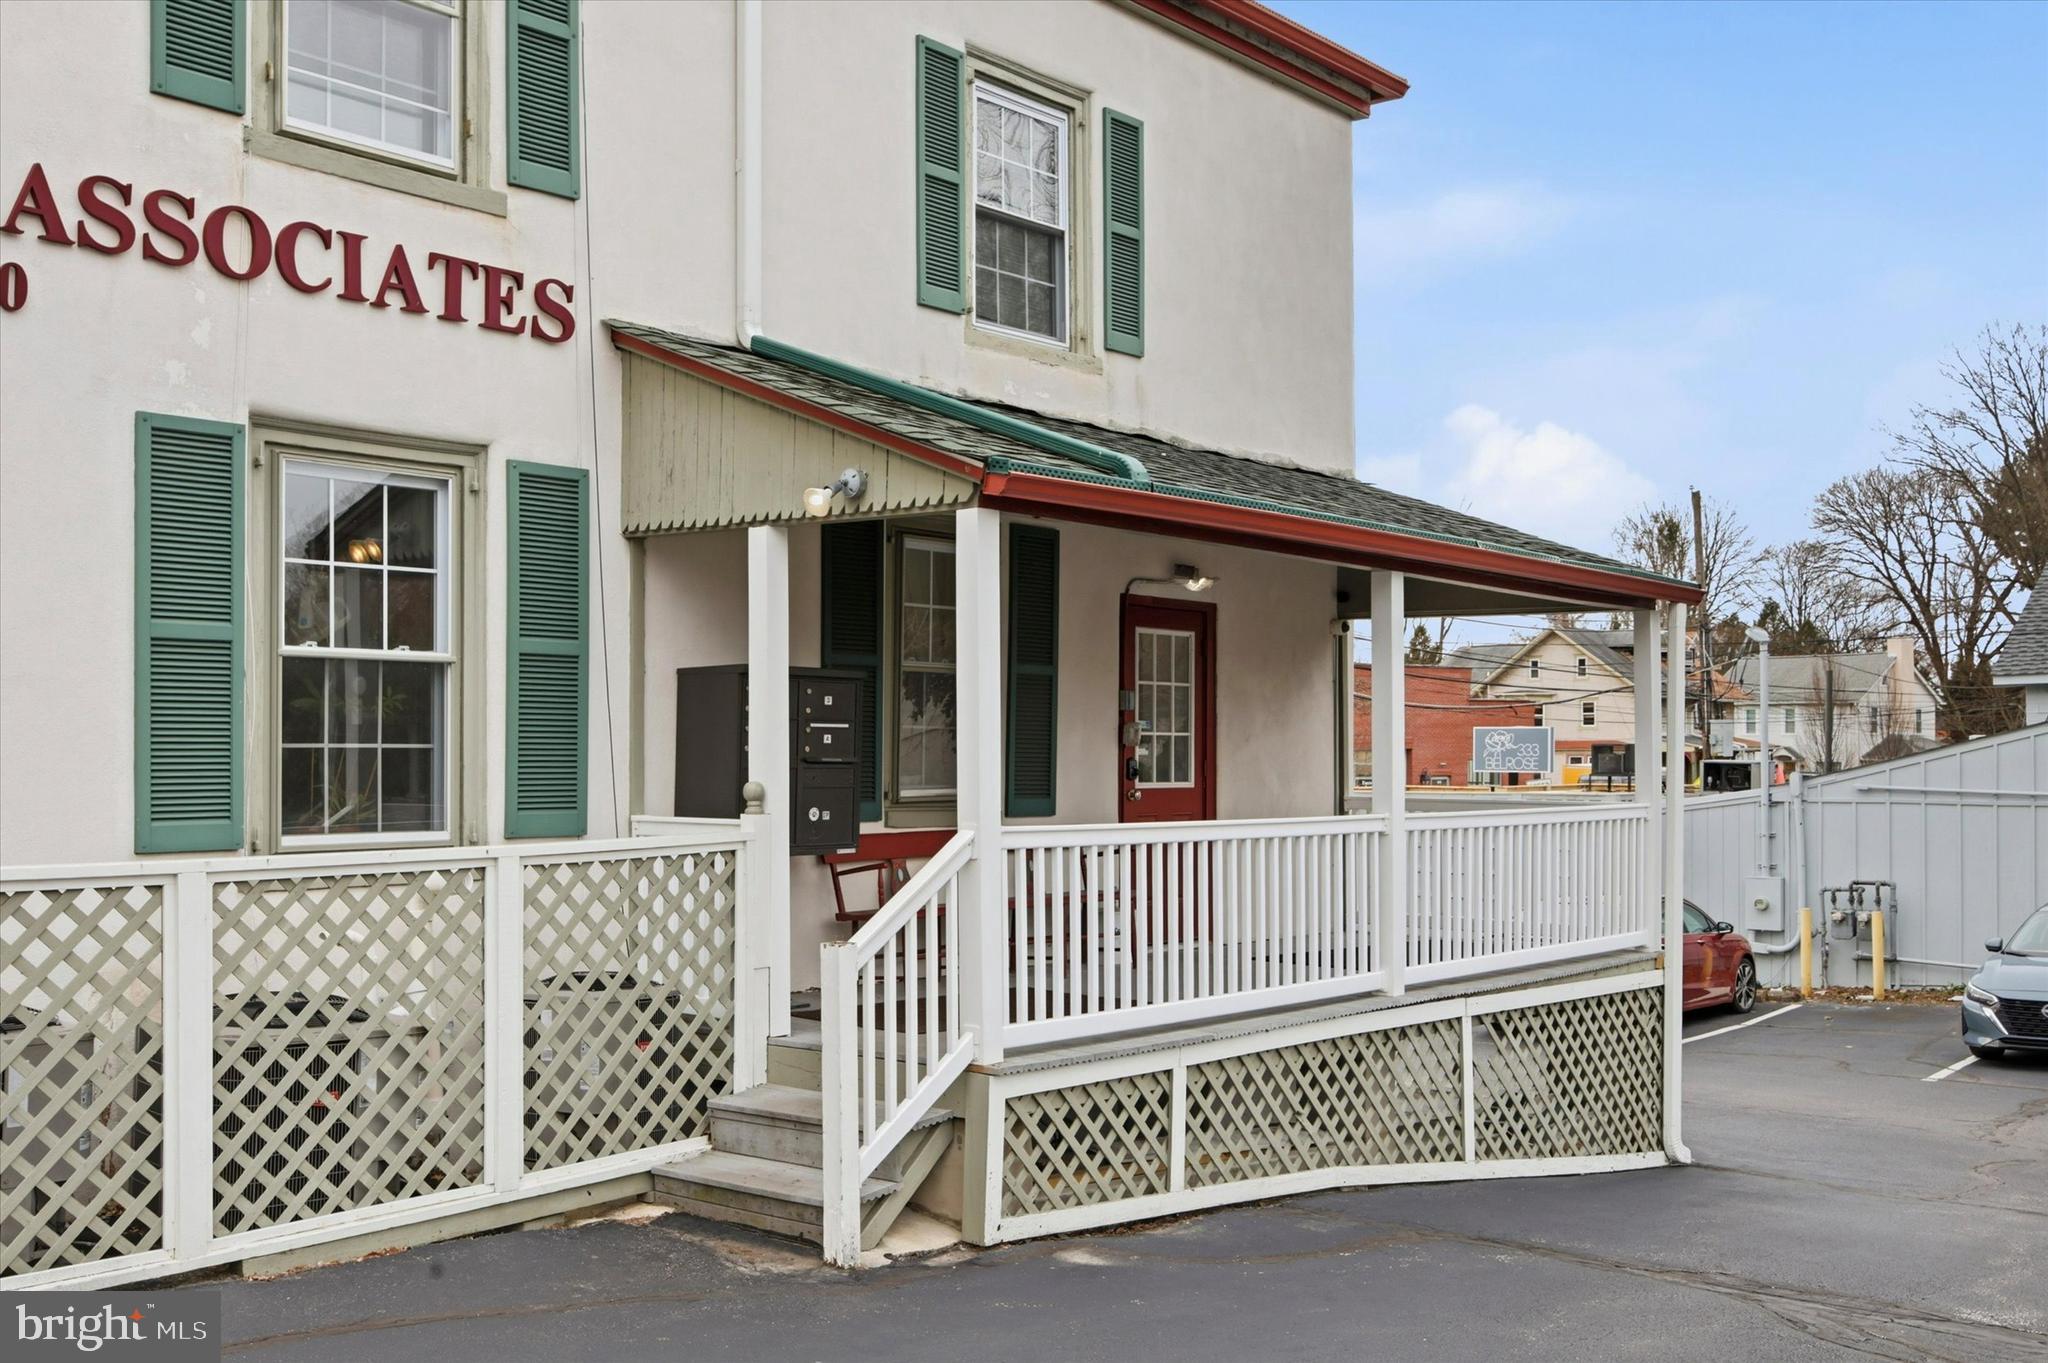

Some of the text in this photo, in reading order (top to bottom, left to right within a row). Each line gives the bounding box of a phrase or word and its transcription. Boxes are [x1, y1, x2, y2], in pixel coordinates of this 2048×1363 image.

[0, 162, 577, 345] ASSOCIATES
[1517, 743, 1540, 757] 333
[1485, 757, 1539, 770] BELROSE
